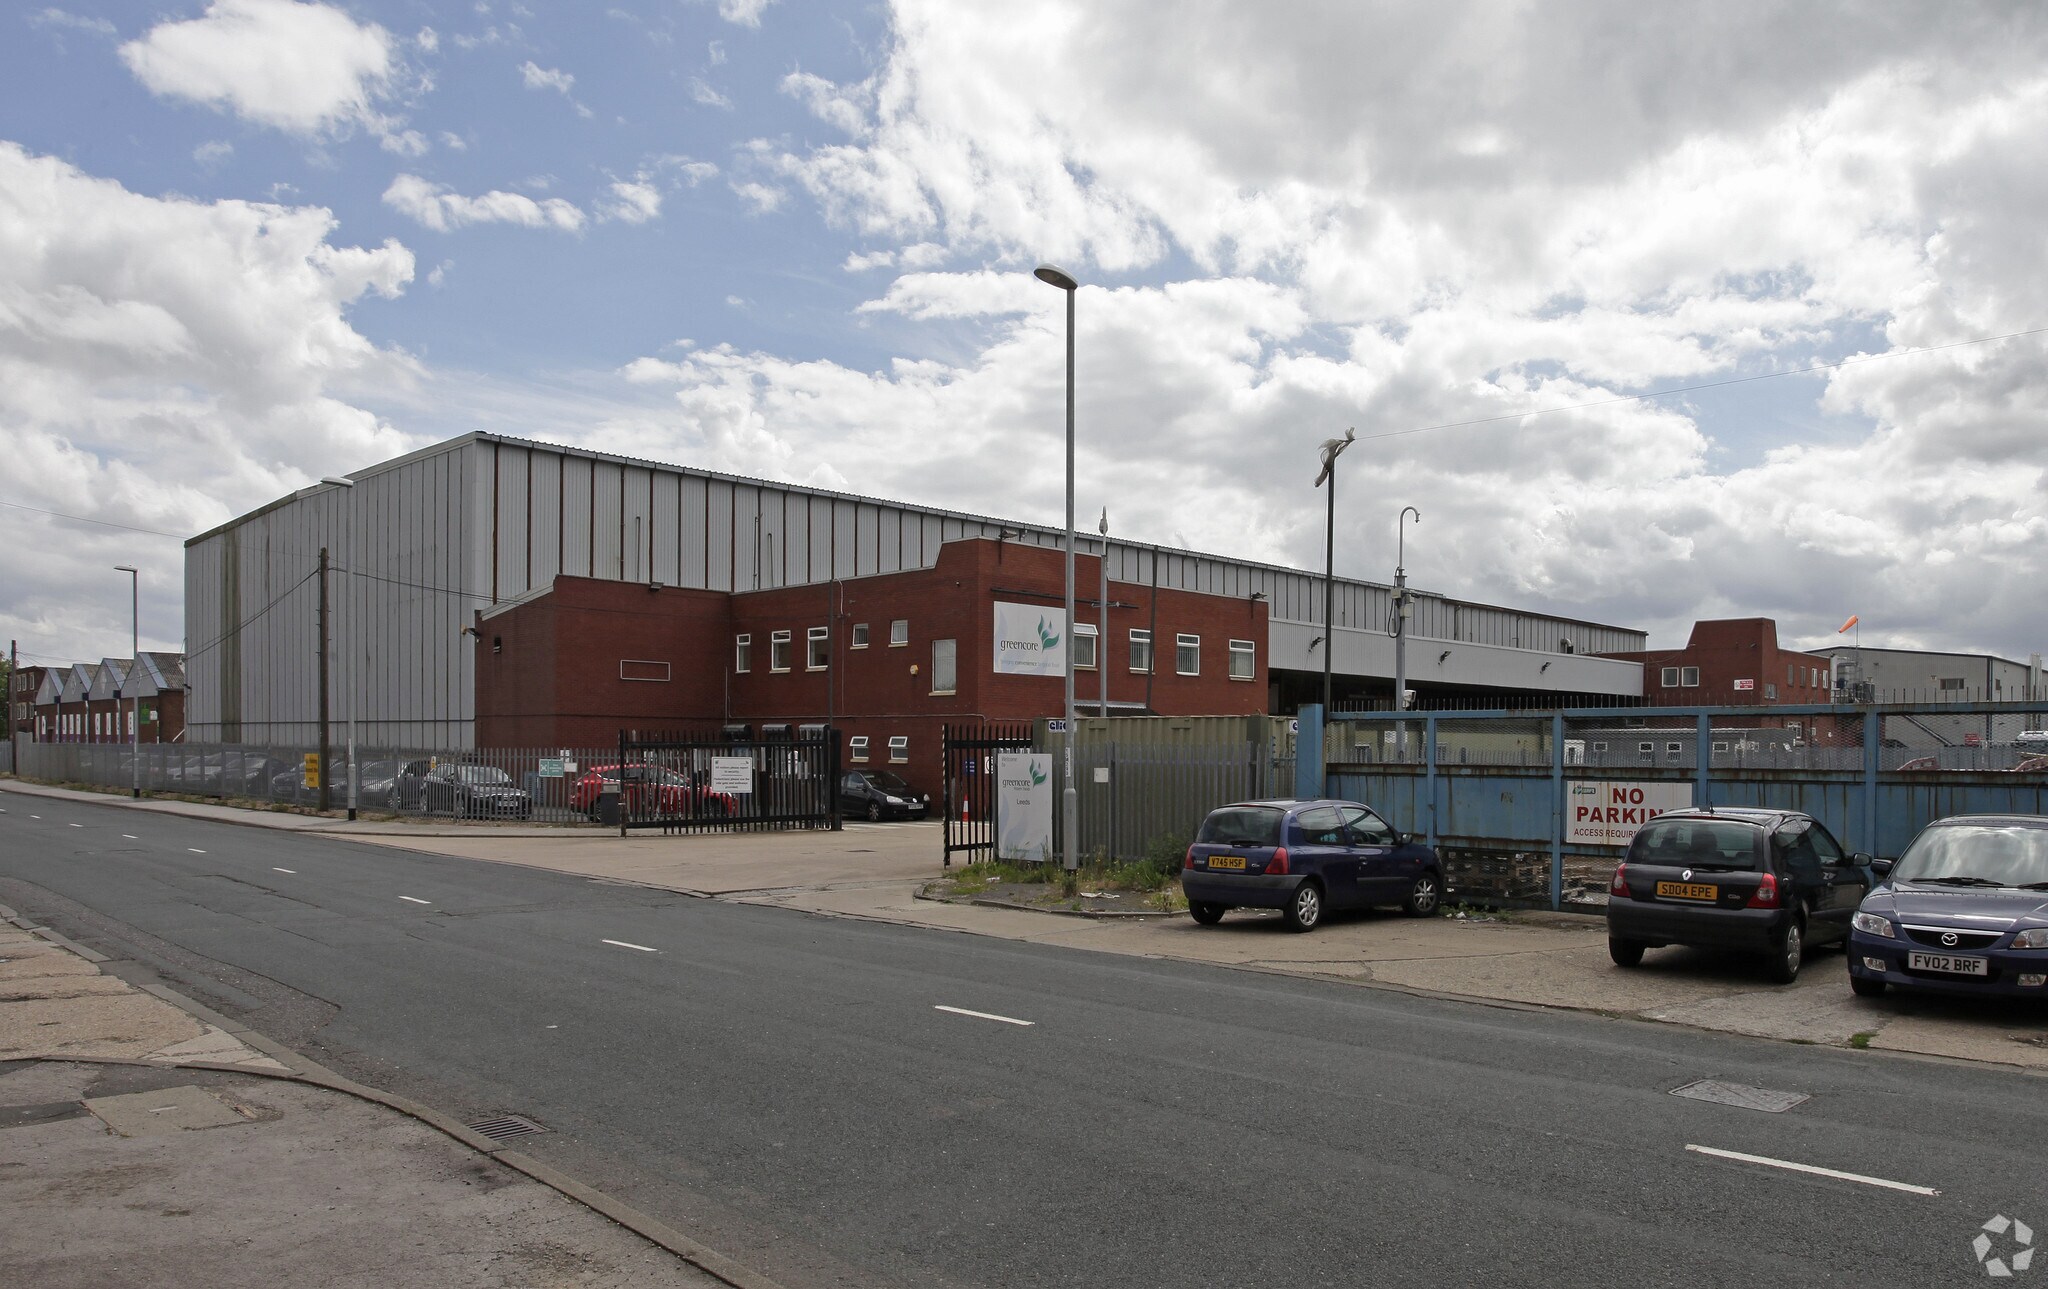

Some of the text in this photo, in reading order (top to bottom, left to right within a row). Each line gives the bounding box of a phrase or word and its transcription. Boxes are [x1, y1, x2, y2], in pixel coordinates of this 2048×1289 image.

[1000, 639, 1039, 651] greencore
[1002, 779, 1031, 788] greencore
[1016, 798, 1031, 806] Leeds
[1612, 788, 1645, 804] NO
[1577, 806, 1664, 824] PARKIN
[1574, 828, 1604, 837] ACCESS
[1211, 857, 1228, 867] Y745
[1229, 858, 1243, 868] HSF
[1662, 884, 1712, 897] SD04 EPE
[1914, 955, 1981, 972] FV02 BRF
